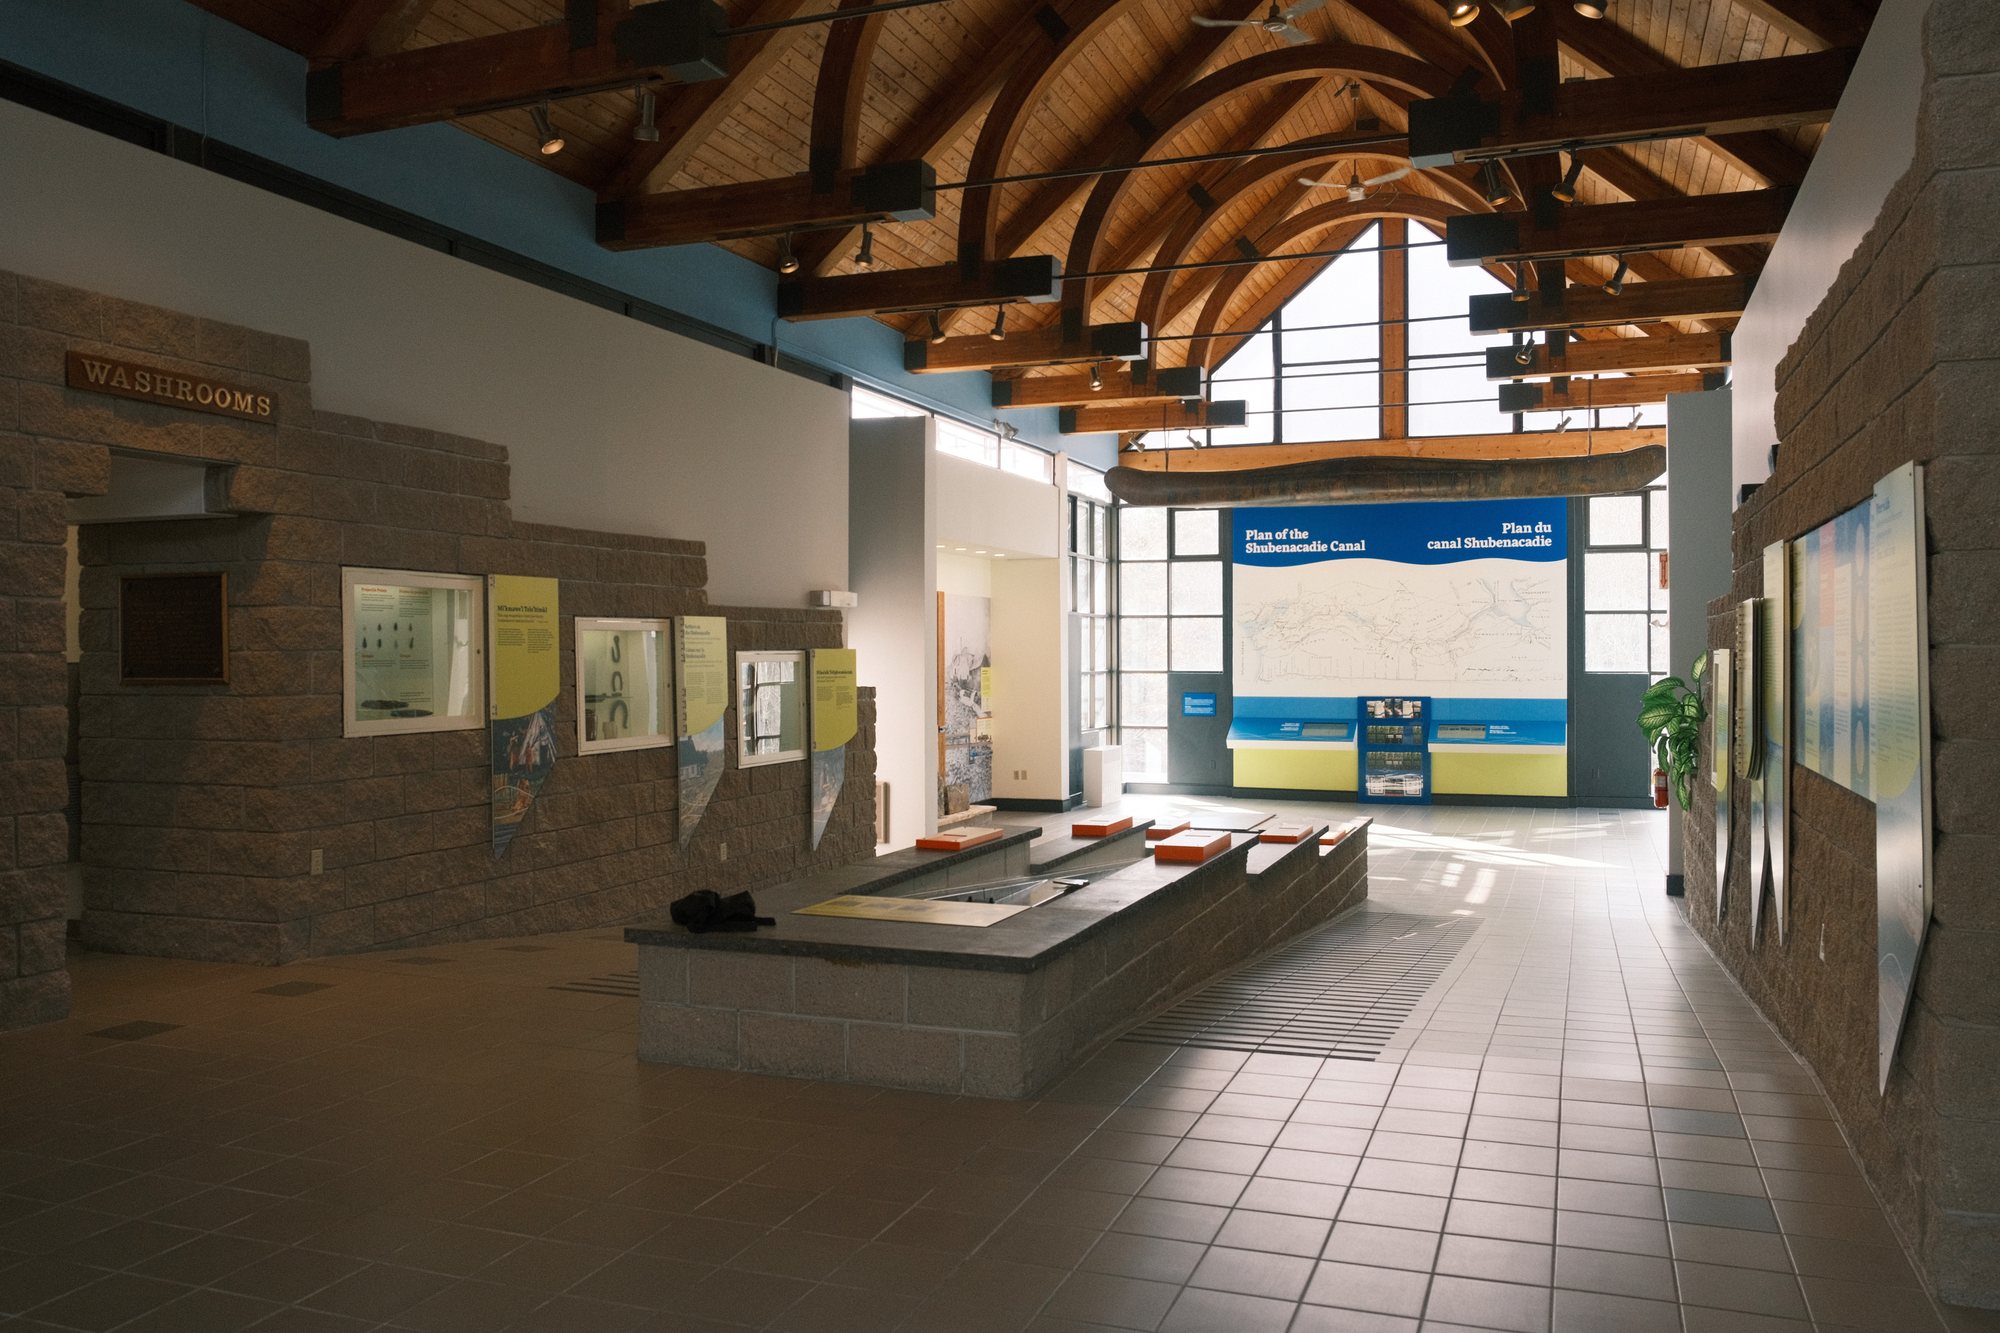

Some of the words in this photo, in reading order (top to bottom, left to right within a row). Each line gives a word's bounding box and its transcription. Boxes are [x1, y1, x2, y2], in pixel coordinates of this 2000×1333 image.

[80, 358, 272, 417] WASHROOMS
[1245, 529, 1273, 541] Plan
[1275, 528, 1289, 540] of
[1289, 528, 1309, 540] the
[1502, 522, 1532, 535] Plan
[1534, 521, 1553, 534] du
[1245, 540, 1328, 554] Shubenacadie
[1329, 540, 1366, 552] Canal
[1427, 537, 1462, 550] canal
[1464, 535, 1553, 549] Shubenacadie
